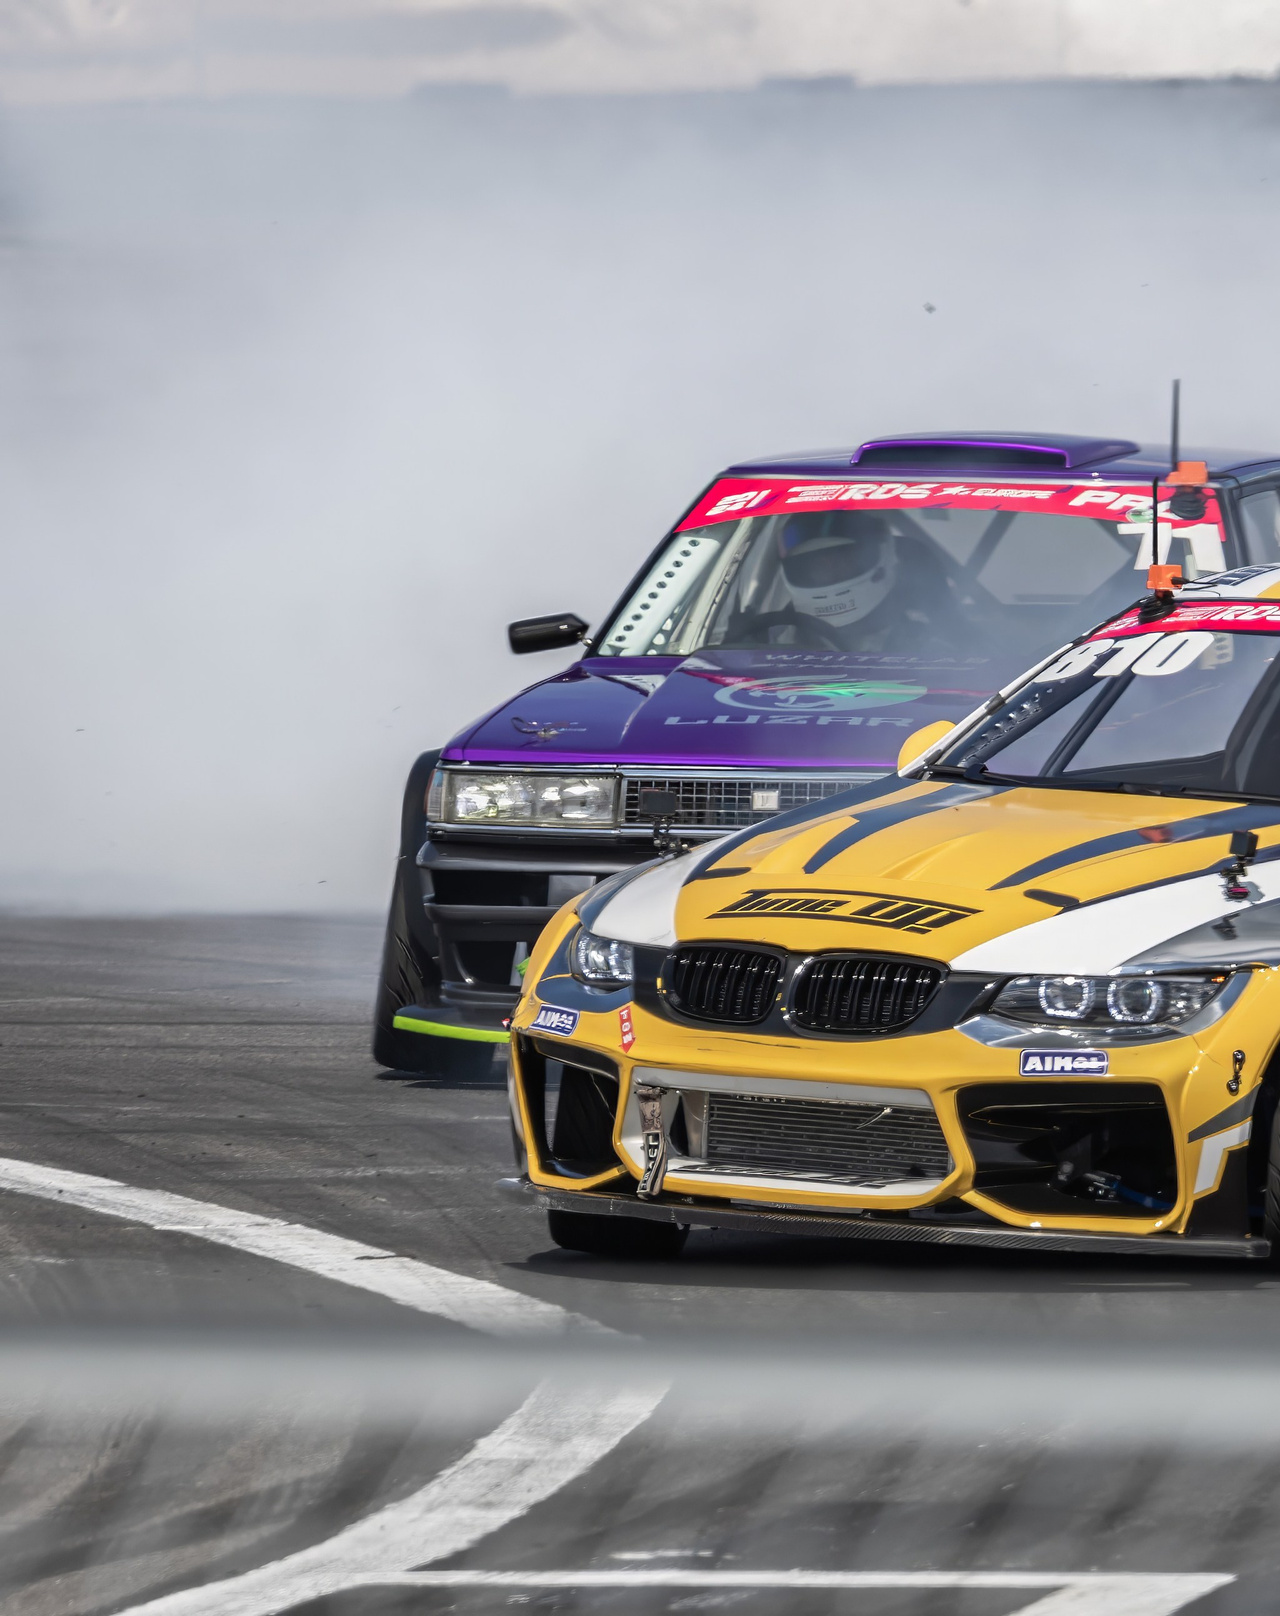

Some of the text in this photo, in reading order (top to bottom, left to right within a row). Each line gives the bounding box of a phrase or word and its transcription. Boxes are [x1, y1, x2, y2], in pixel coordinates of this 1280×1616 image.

[837, 484, 941, 500] RDS
[971, 488, 1056, 499] EUROPE
[1032, 631, 1214, 683] 810
[664, 715, 914, 728] LUZAR
[620, 1009, 633, 1044] TOW
